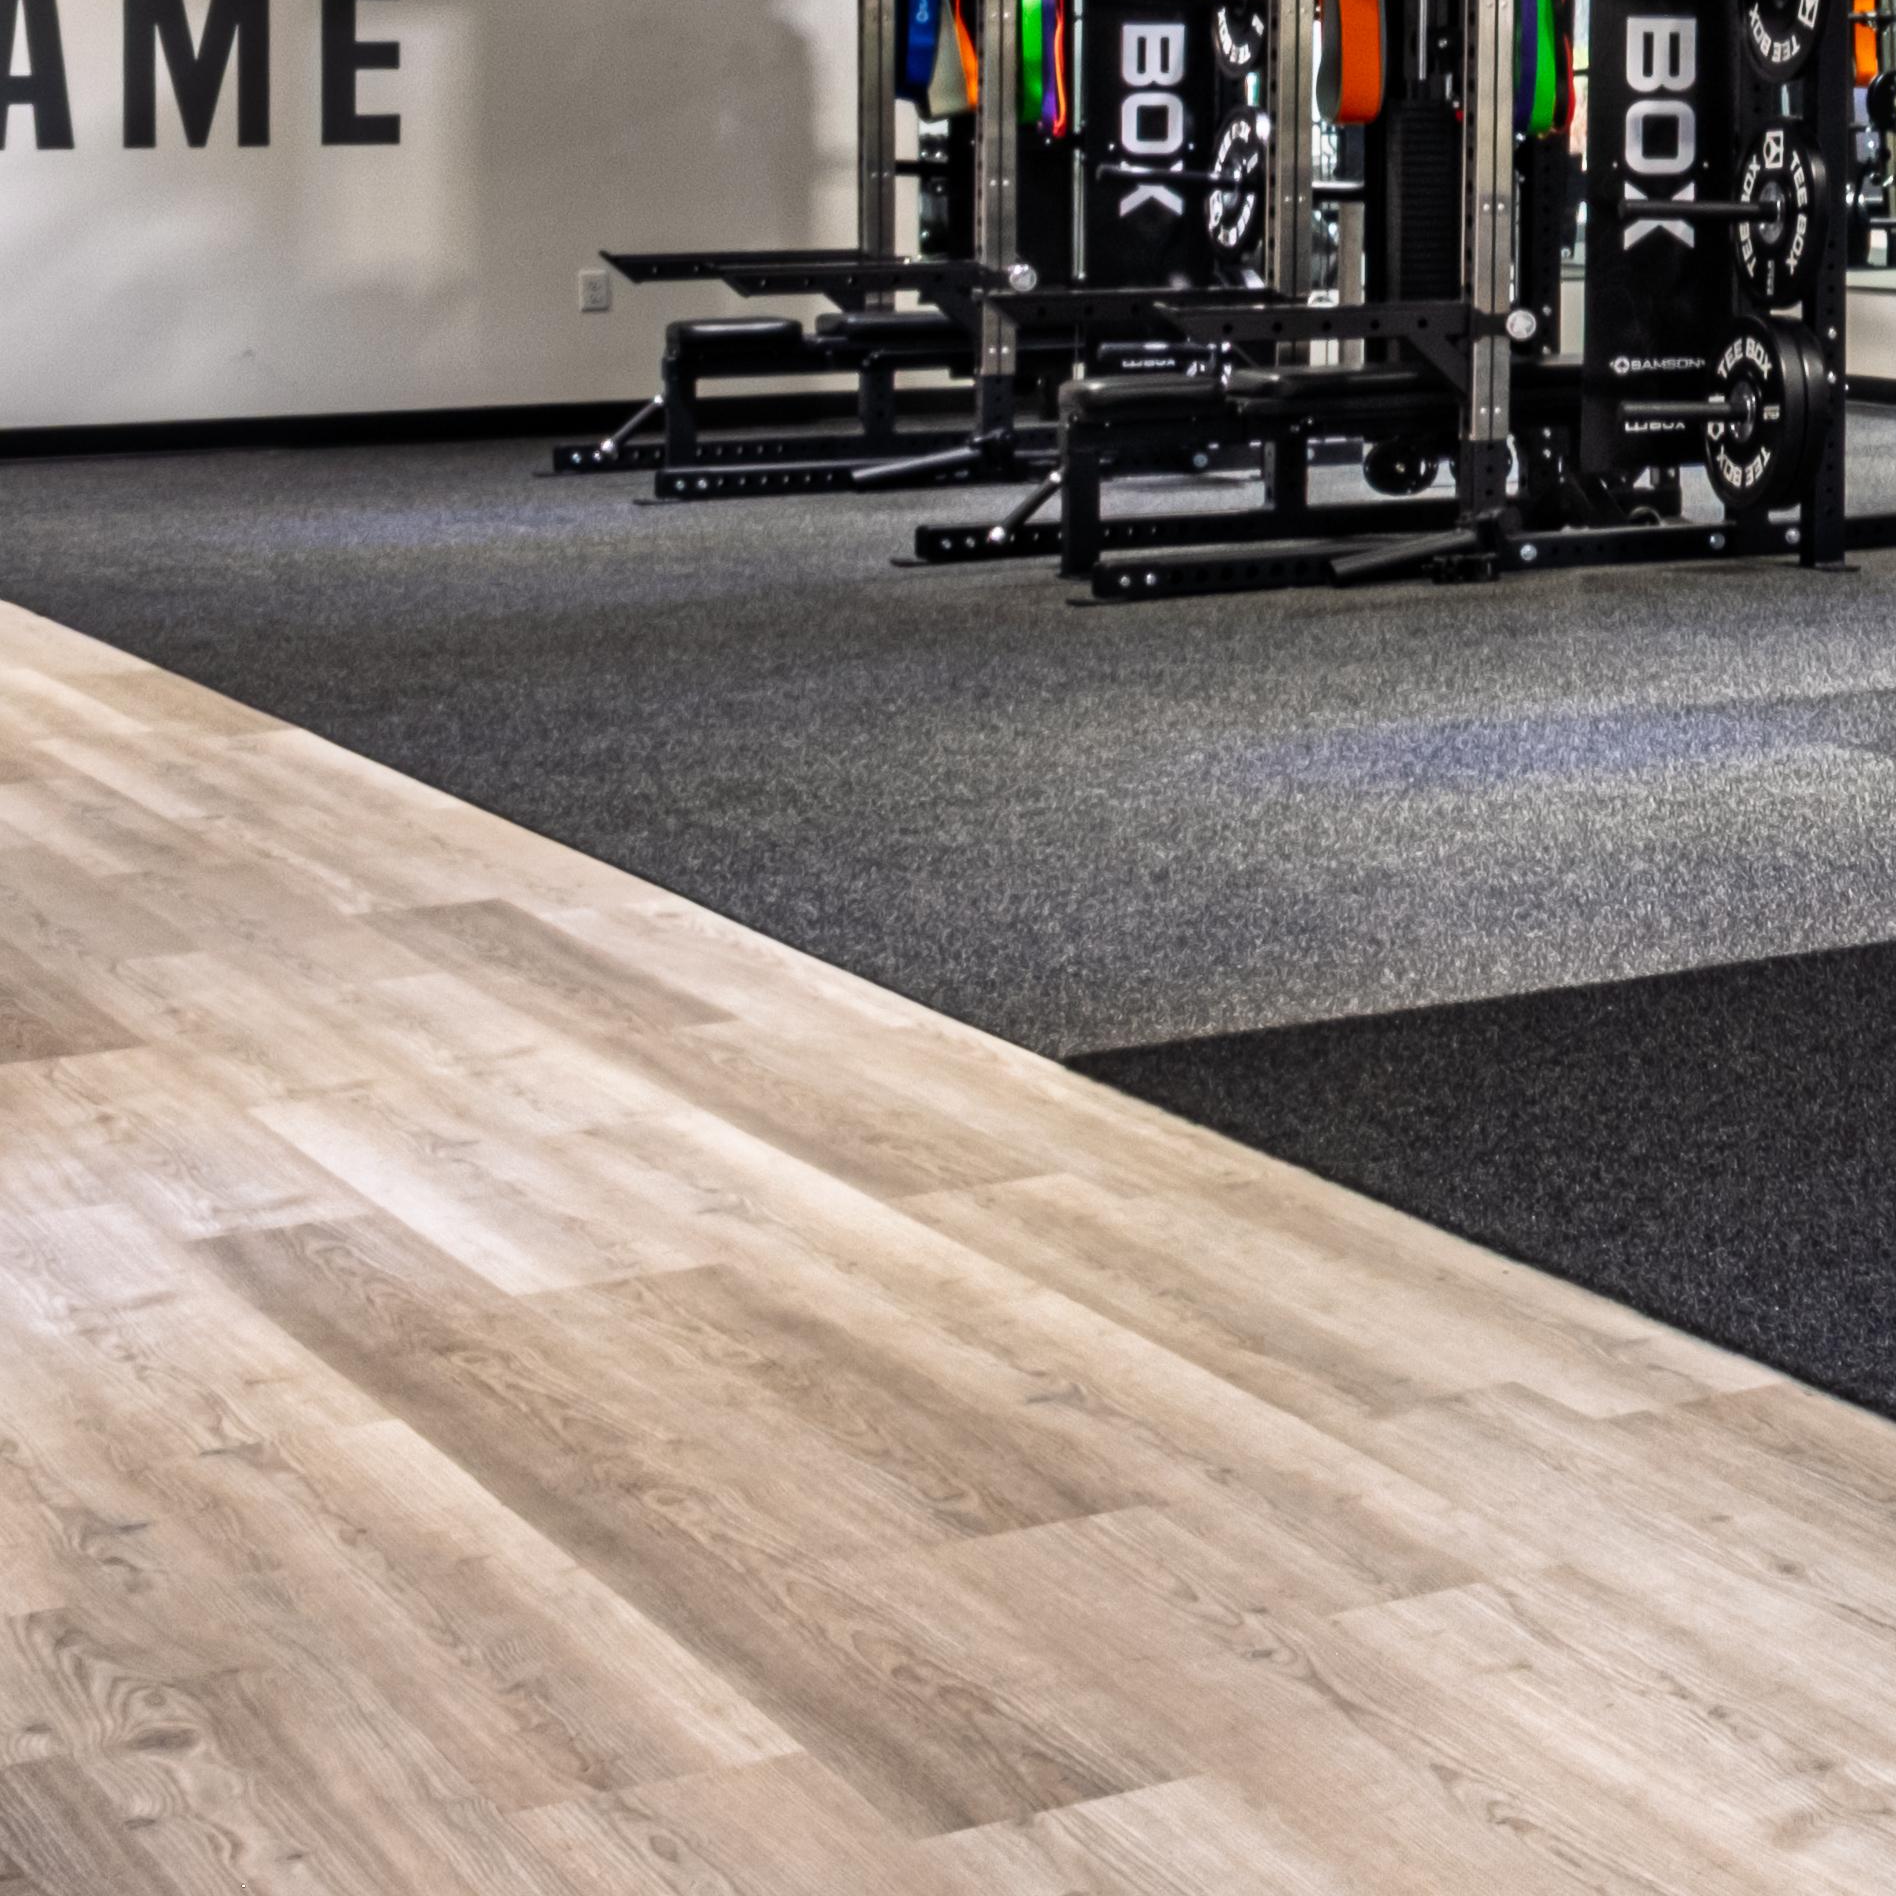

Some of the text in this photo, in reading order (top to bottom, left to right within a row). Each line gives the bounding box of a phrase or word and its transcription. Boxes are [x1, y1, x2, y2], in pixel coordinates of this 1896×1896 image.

[1749, 2, 1800, 63] TEE BOX
[1119, 22, 1186, 217] BOX
[1624, 16, 1698, 251] BOX
[1785, 150, 1808, 276] TEE BOX
[1630, 357, 1701, 371] SAMSON
[1717, 337, 1772, 379] TEE BOX
[1716, 445, 1771, 488] TEE BOX
